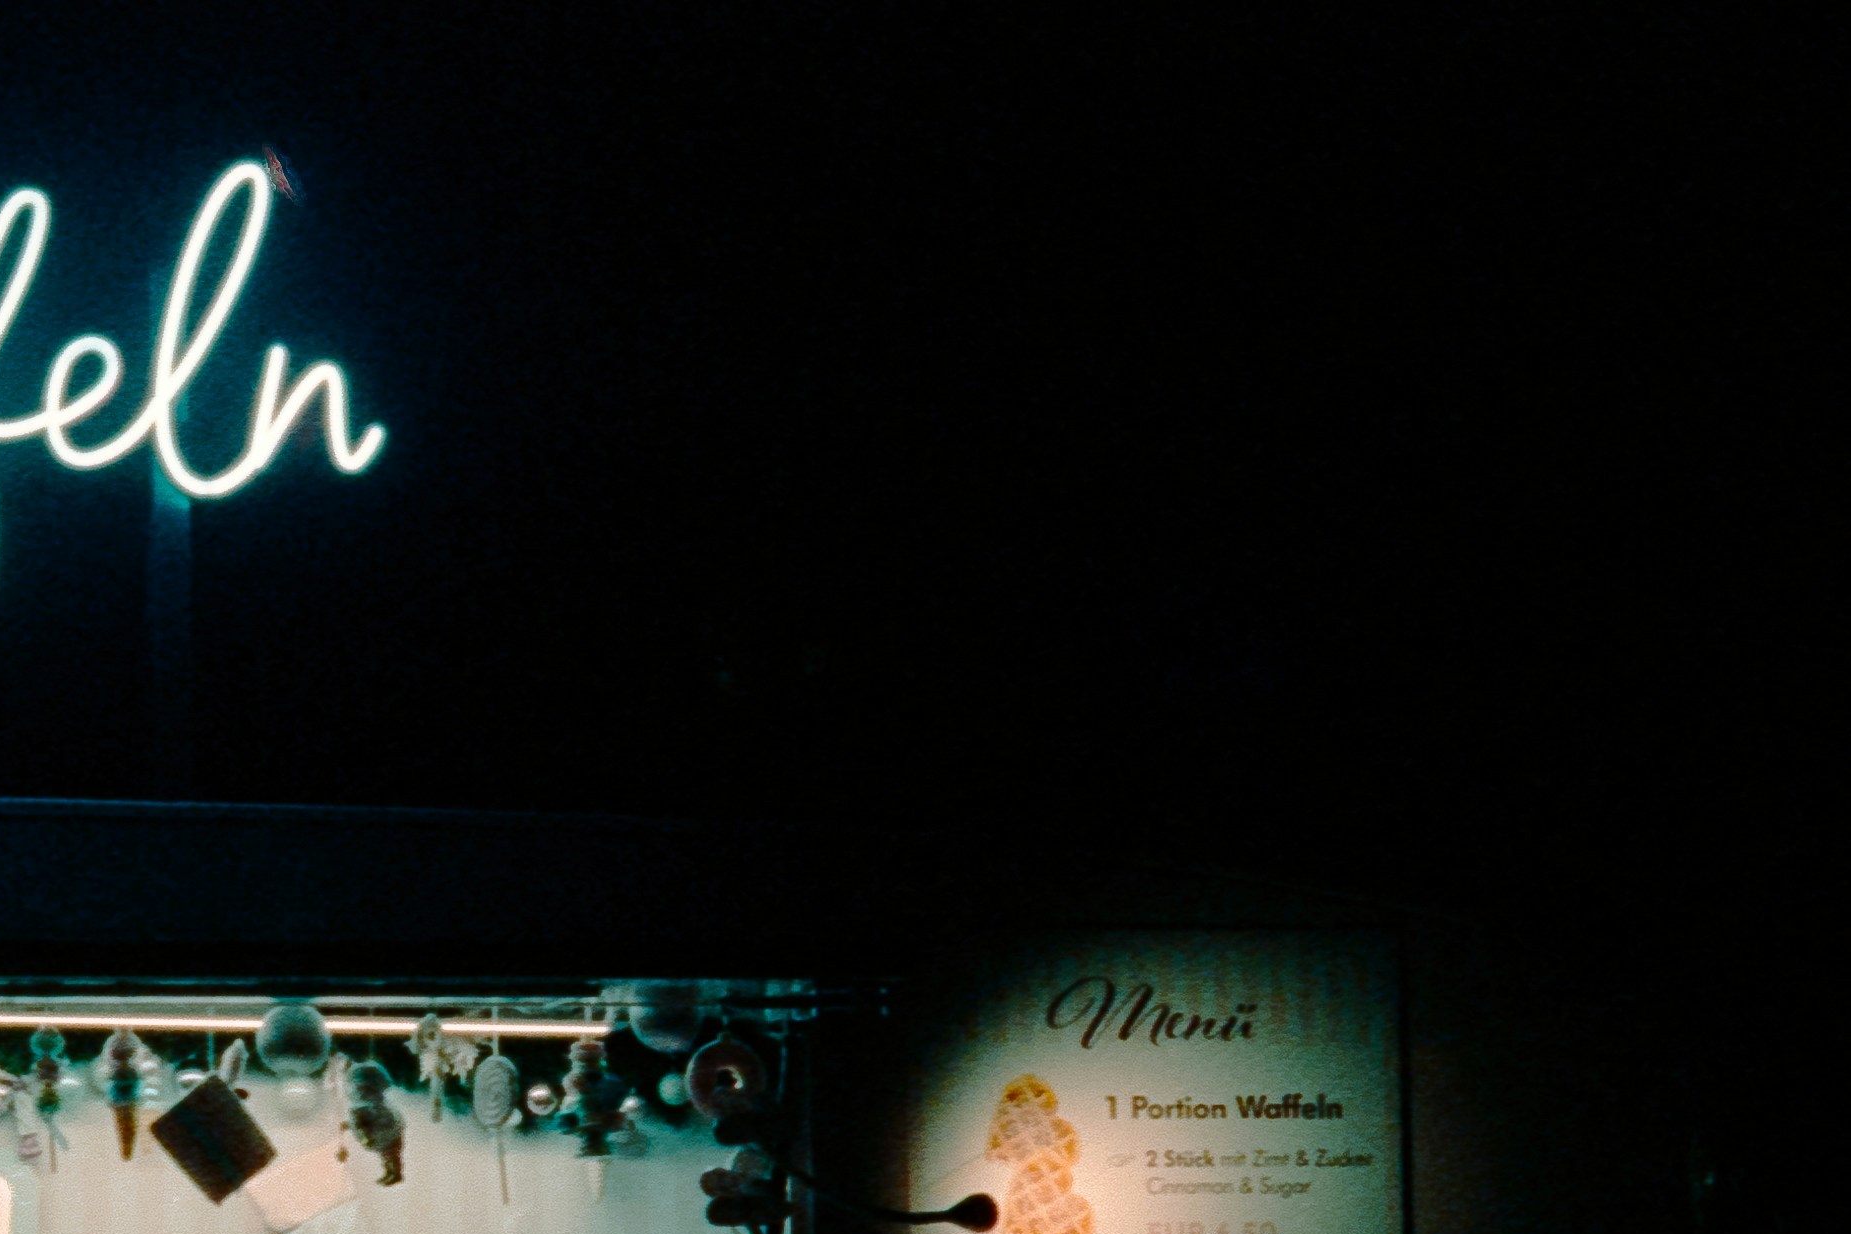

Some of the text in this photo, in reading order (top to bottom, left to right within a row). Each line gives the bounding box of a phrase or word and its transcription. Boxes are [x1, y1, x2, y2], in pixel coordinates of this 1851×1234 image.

[1048, 976, 1257, 1049] Menü
[1105, 1093, 1344, 1120] 1 Portion Waffeln
[1147, 1149, 1158, 1168] 2
[1164, 1148, 1215, 1168] Stück
[1295, 1149, 1309, 1168] &
[1146, 1176, 1311, 1199] Cinnamon & Sugar
